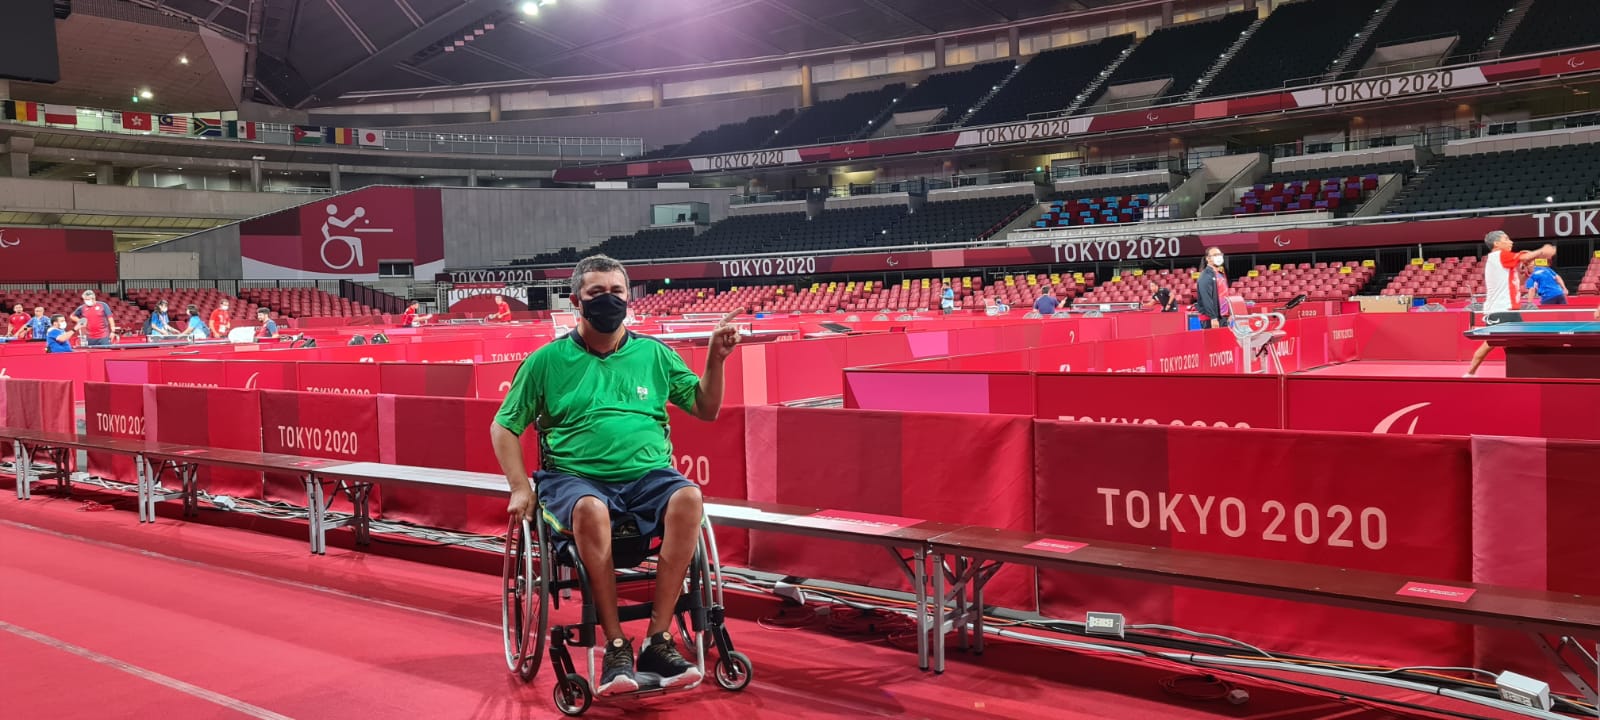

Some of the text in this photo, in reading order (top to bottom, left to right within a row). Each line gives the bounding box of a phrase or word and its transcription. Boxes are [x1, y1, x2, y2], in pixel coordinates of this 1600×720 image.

[1321, 70, 1453, 103] TOKYO 2020
[977, 120, 1070, 144] TOKYO 2020
[708, 151, 784, 169] TOKYO 2020
[1051, 237, 1181, 263] TOKYO 2020
[449, 270, 533, 283] TOKYO 2020
[720, 257, 816, 277] TOKYO 2020
[491, 353, 522, 363] TOKYO
[1160, 356, 1183, 373] TOKYO
[1183, 353, 1200, 370] 2020
[1209, 350, 1234, 368] TOYOTA
[96, 412, 146, 435] TOKYO 202
[278, 425, 358, 455] TOKYO 2020
[671, 454, 710, 486] 20
[1097, 487, 1388, 550] TOKYO 2020
